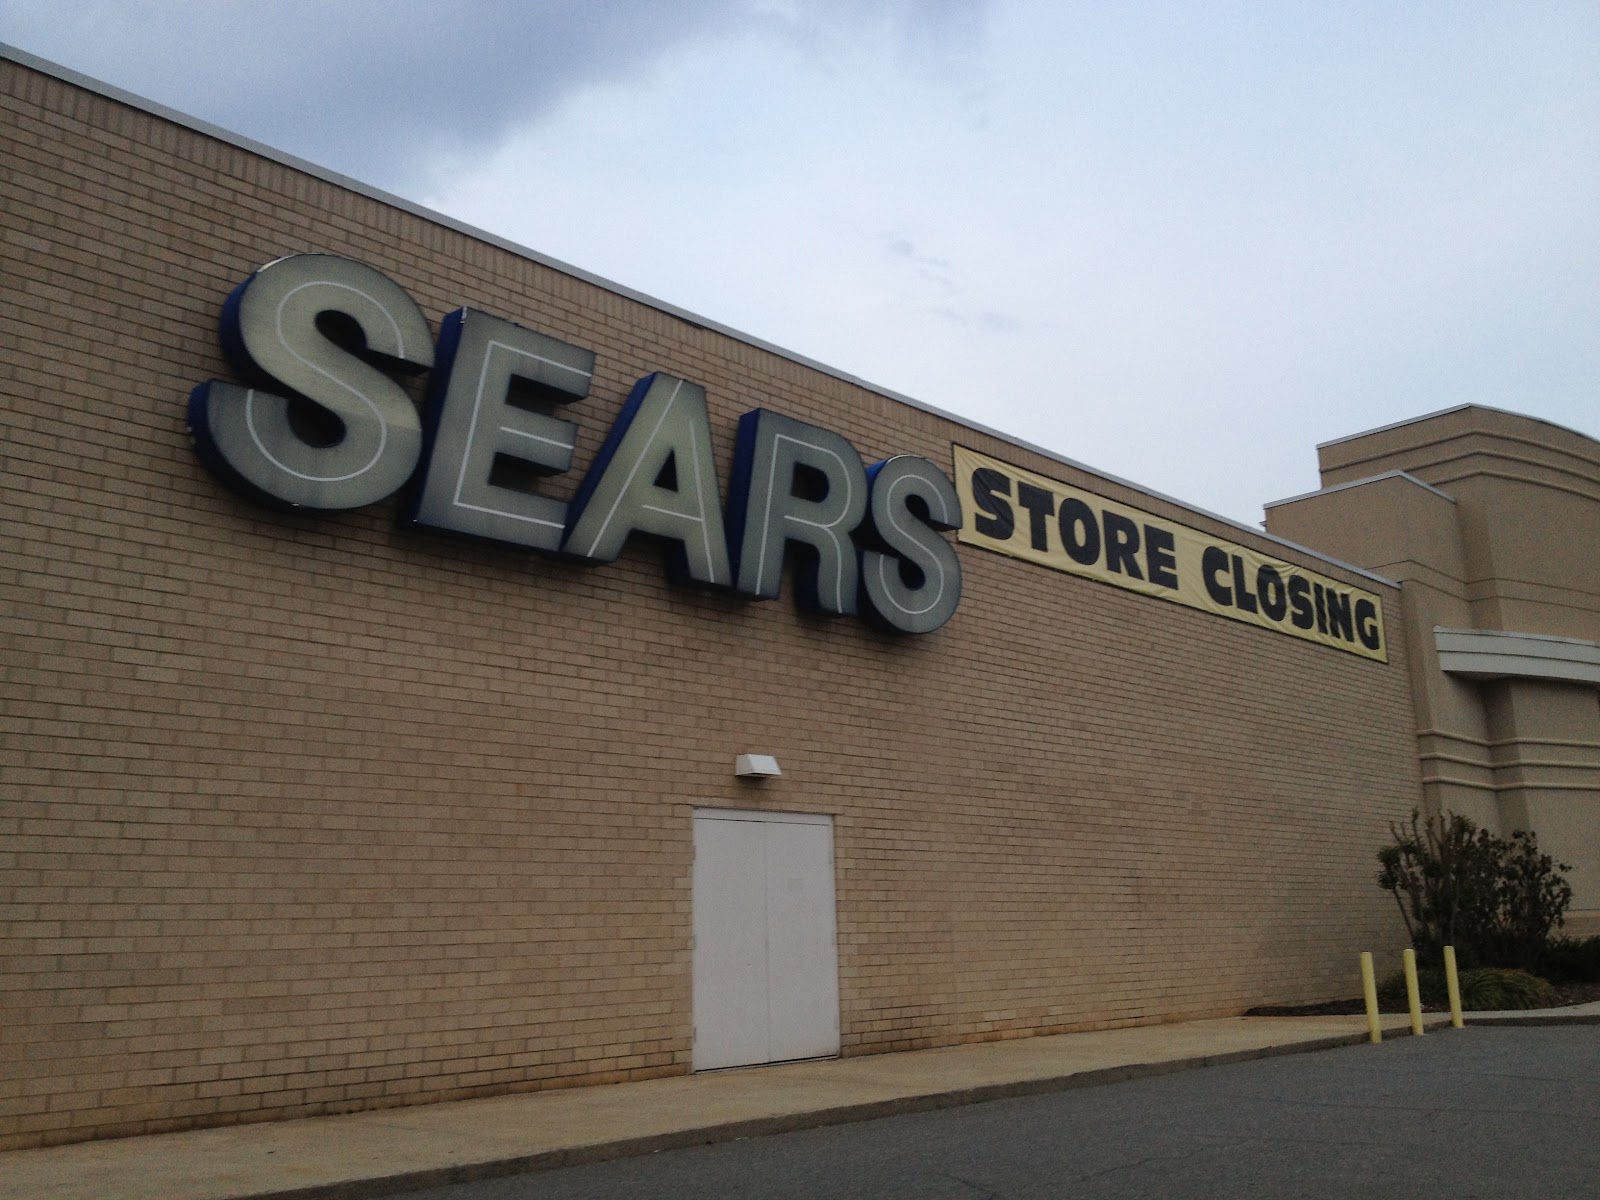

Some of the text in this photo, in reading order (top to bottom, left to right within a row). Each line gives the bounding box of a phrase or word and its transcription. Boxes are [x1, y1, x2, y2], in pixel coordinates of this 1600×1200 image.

[188, 252, 962, 635] SEARS
[971, 467, 1380, 650] STORE CLOSING
